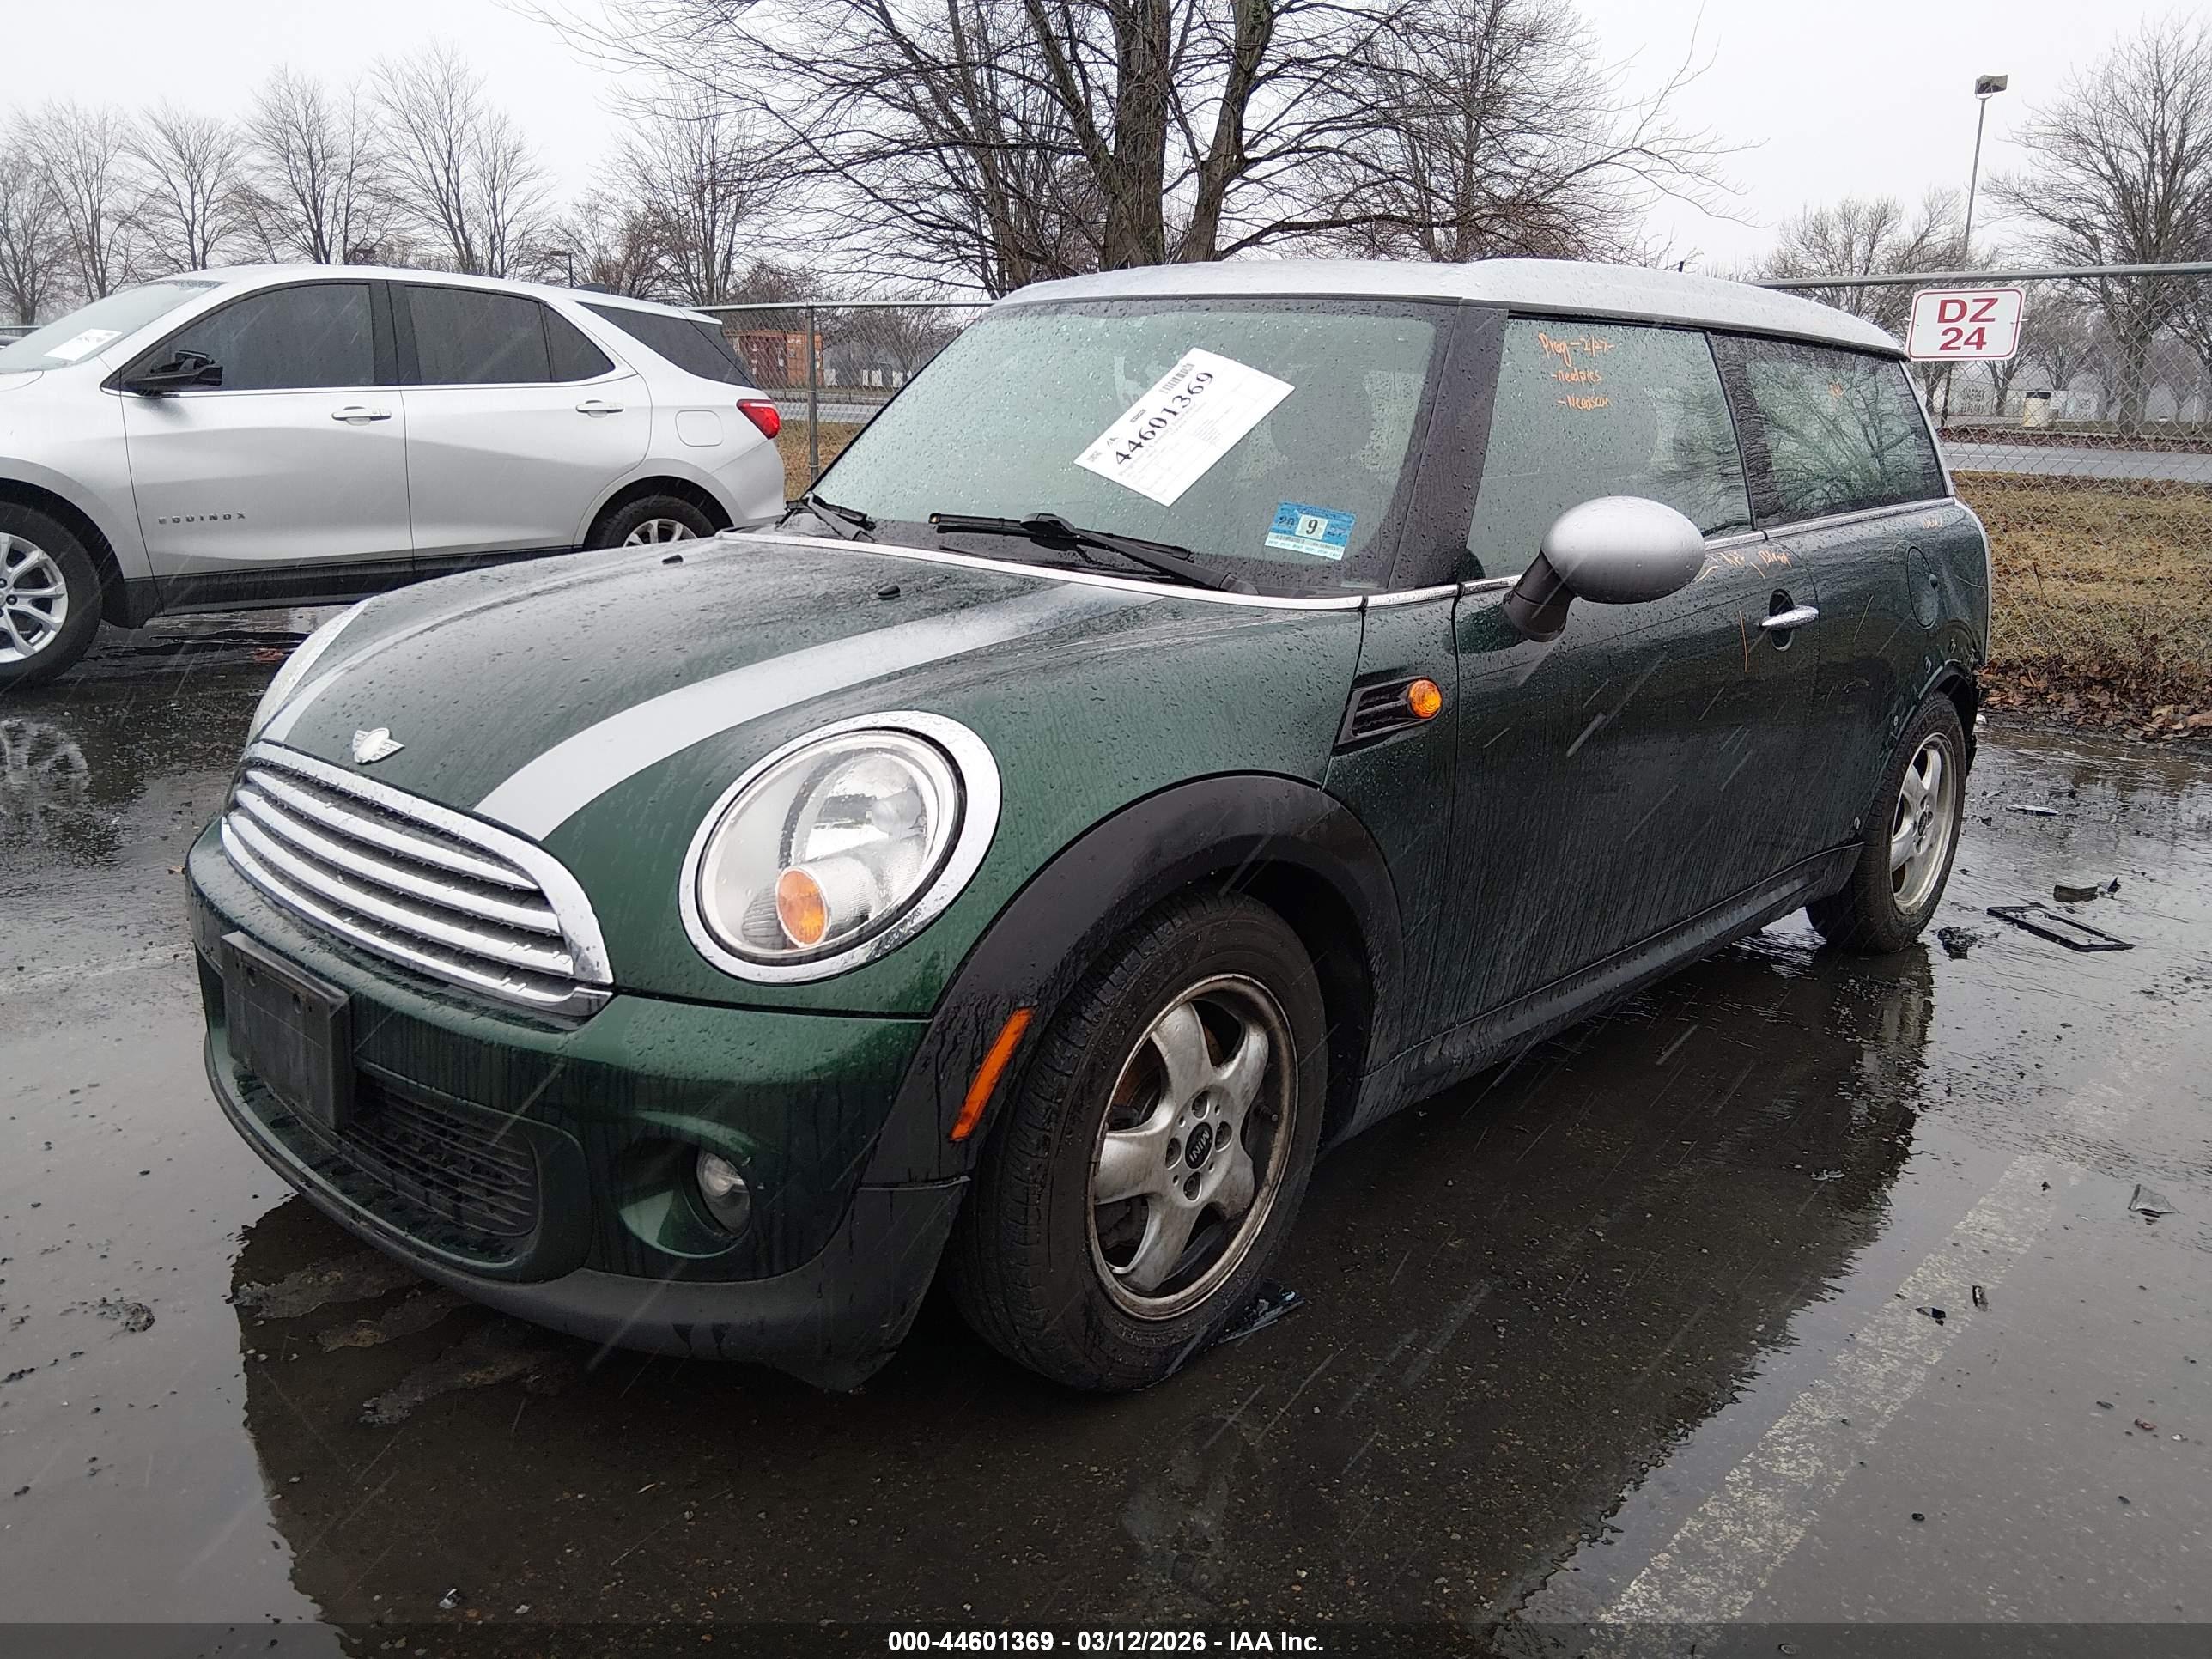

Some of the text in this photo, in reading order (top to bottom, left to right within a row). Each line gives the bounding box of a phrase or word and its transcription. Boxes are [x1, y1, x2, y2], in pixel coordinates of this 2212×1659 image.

[1937, 297, 1999, 324] DZ
[1939, 327, 1987, 351] 24
[1115, 372, 1214, 465] 44601369
[158, 512, 246, 525] EQUINOX
[1305, 520, 1318, 535] 9
[1189, 1130, 1210, 1162] MINI
